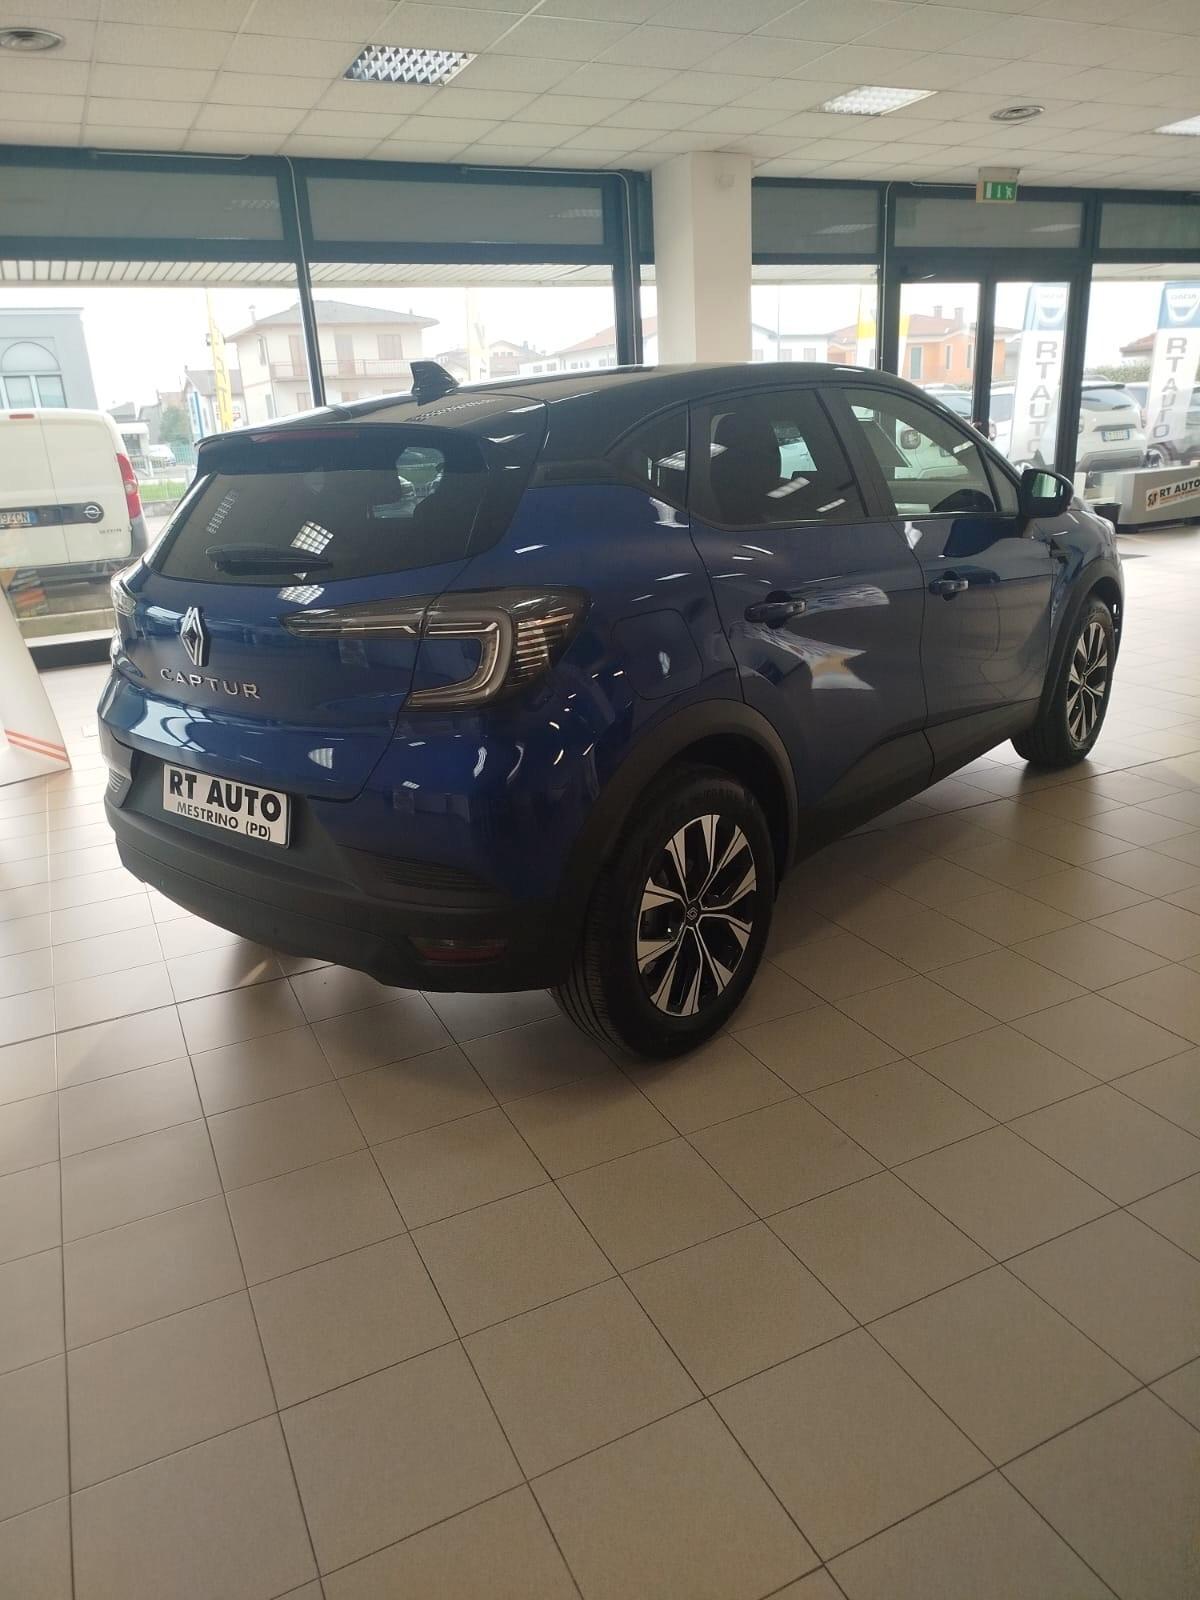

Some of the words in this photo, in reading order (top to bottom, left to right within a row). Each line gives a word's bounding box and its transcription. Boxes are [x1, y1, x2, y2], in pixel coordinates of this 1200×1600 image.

[1159, 486, 1171, 498] RT
[160, 668, 261, 700] CAPTUR
[170, 769, 197, 799] RT
[206, 780, 281, 822] AUTO
[176, 801, 239, 830] MESTRINO
[246, 821, 271, 842] (PD)
